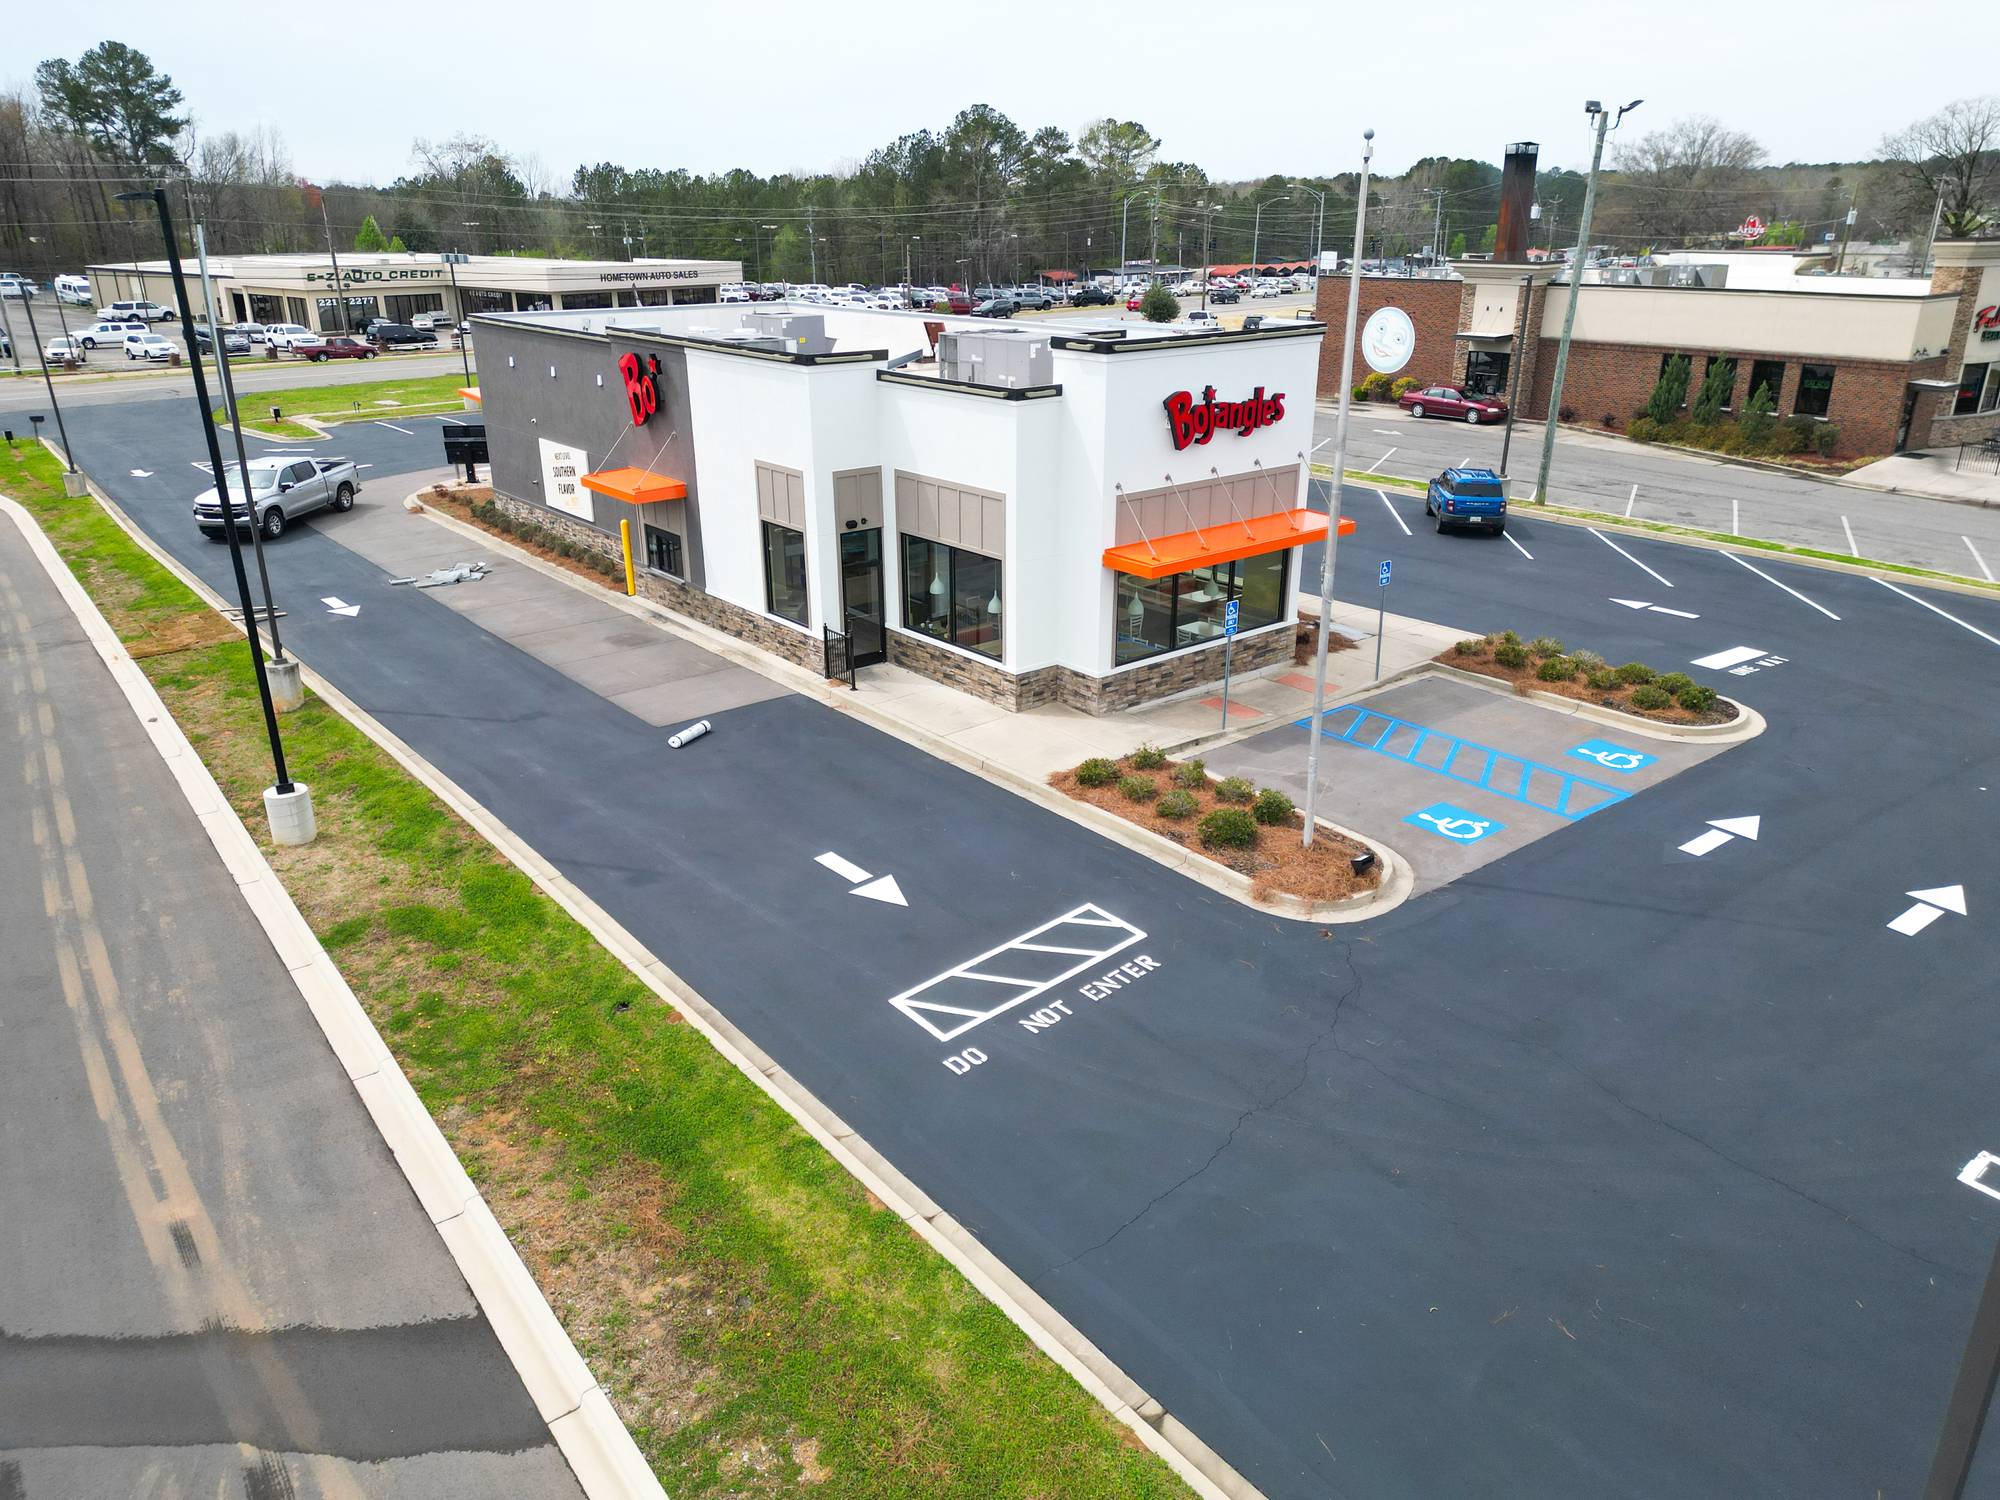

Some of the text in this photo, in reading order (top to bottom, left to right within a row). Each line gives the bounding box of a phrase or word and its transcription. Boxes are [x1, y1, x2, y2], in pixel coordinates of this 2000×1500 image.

[1737, 224, 1765, 236] Arby's
[307, 269, 443, 281] E-Z AUTO CREDIT
[600, 270, 699, 282] HOMETOWN AUTO SALES
[318, 298, 338, 307] 221
[348, 296, 374, 305] 2277
[1163, 385, 1286, 451] Bojangles
[552, 465, 576, 478] SOUTHERN
[558, 483, 575, 495] FLAVOR
[942, 954, 1162, 1076] DO NOT ENTER
